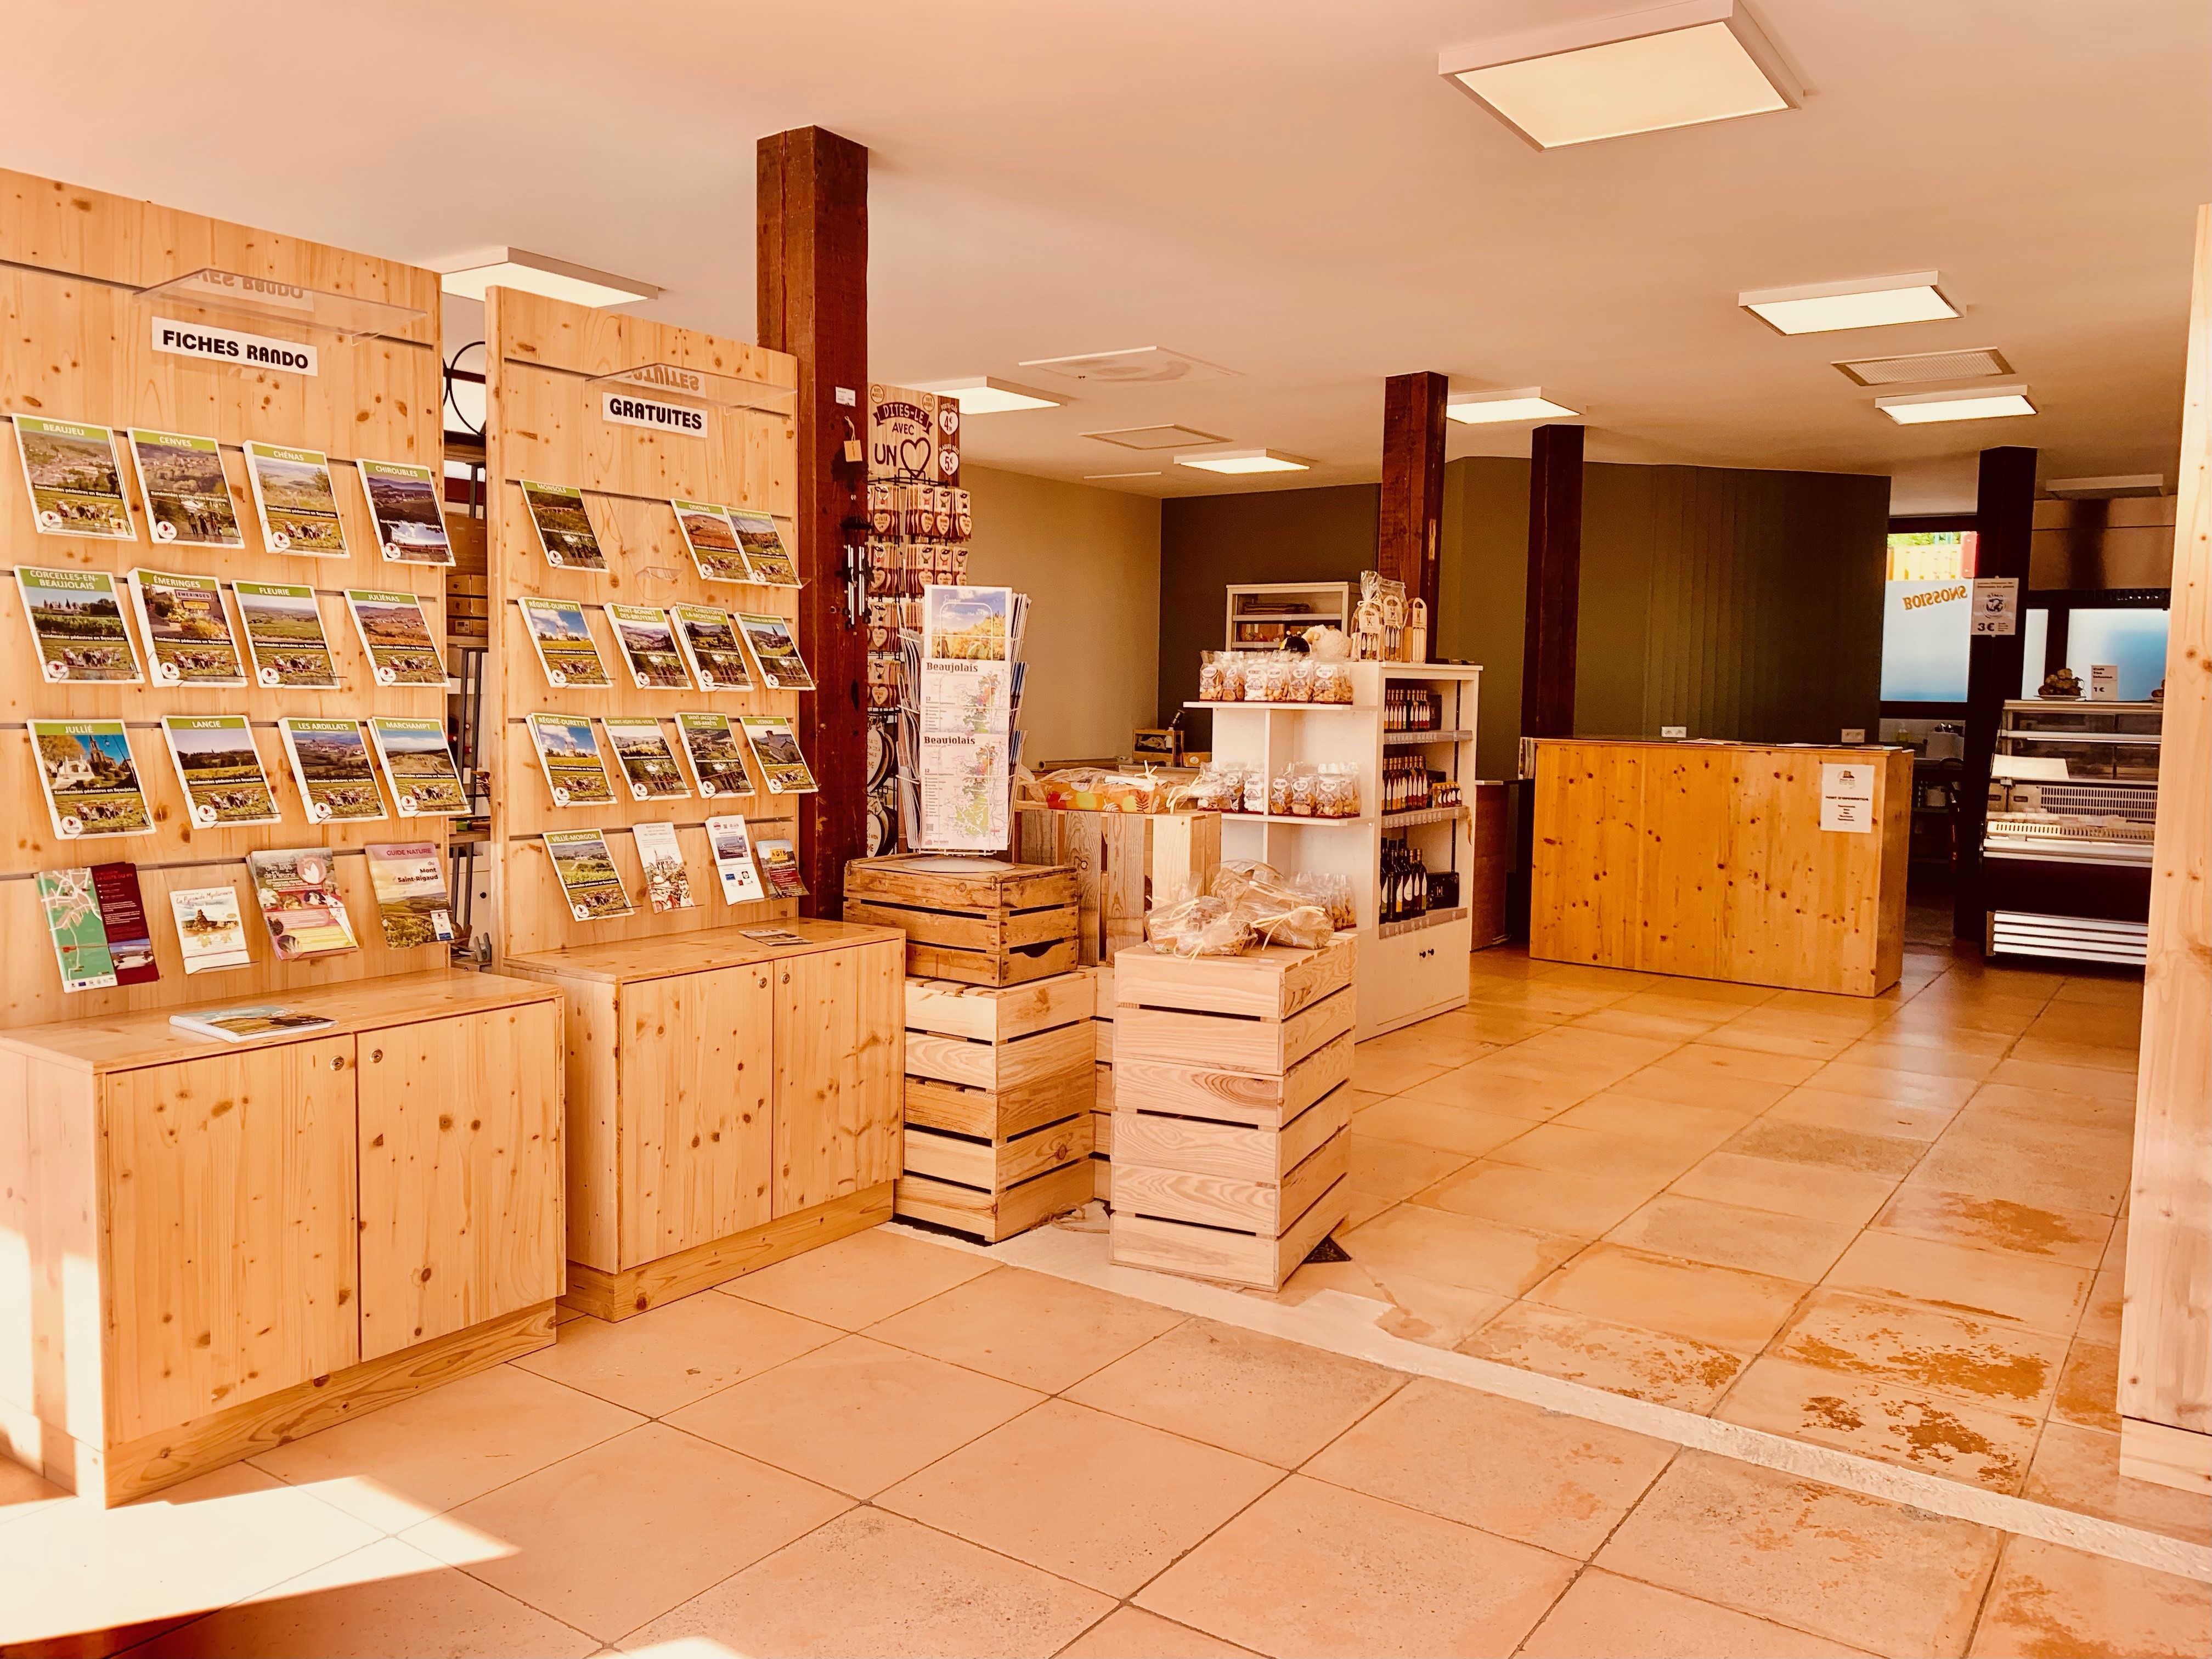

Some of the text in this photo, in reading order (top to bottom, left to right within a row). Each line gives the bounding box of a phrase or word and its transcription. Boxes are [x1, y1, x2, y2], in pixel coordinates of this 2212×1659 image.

[163, 329, 308, 369] FICHES RANDO
[610, 398, 702, 430] GRATUITES
[883, 403, 924, 424] DITES-LE
[43, 423, 84, 436] BEAUJEU
[891, 422, 915, 435] AVEC
[159, 436, 192, 447] CENVES
[273, 450, 304, 461] CHÉNAS
[874, 443, 898, 467] UN
[375, 465, 418, 477] CHIROUBLES
[537, 483, 567, 493] MONSOLS
[689, 504, 710, 512] ODENAS
[30, 570, 99, 582] CORCELLES-EN-
[153, 575, 200, 588] ÉMERINGES
[39, 579, 94, 590] BEAUJOLAIS
[258, 587, 290, 596] FLEURIE
[368, 594, 400, 602] JULIÉNAS
[926, 662, 978, 673] Beaujolais
[65, 724, 93, 733] JULLIÉ
[924, 736, 975, 746] Beaujolais
[551, 833, 597, 842] VILLIÉ-MORGON
[397, 874, 438, 883] Saint-Rigaud
